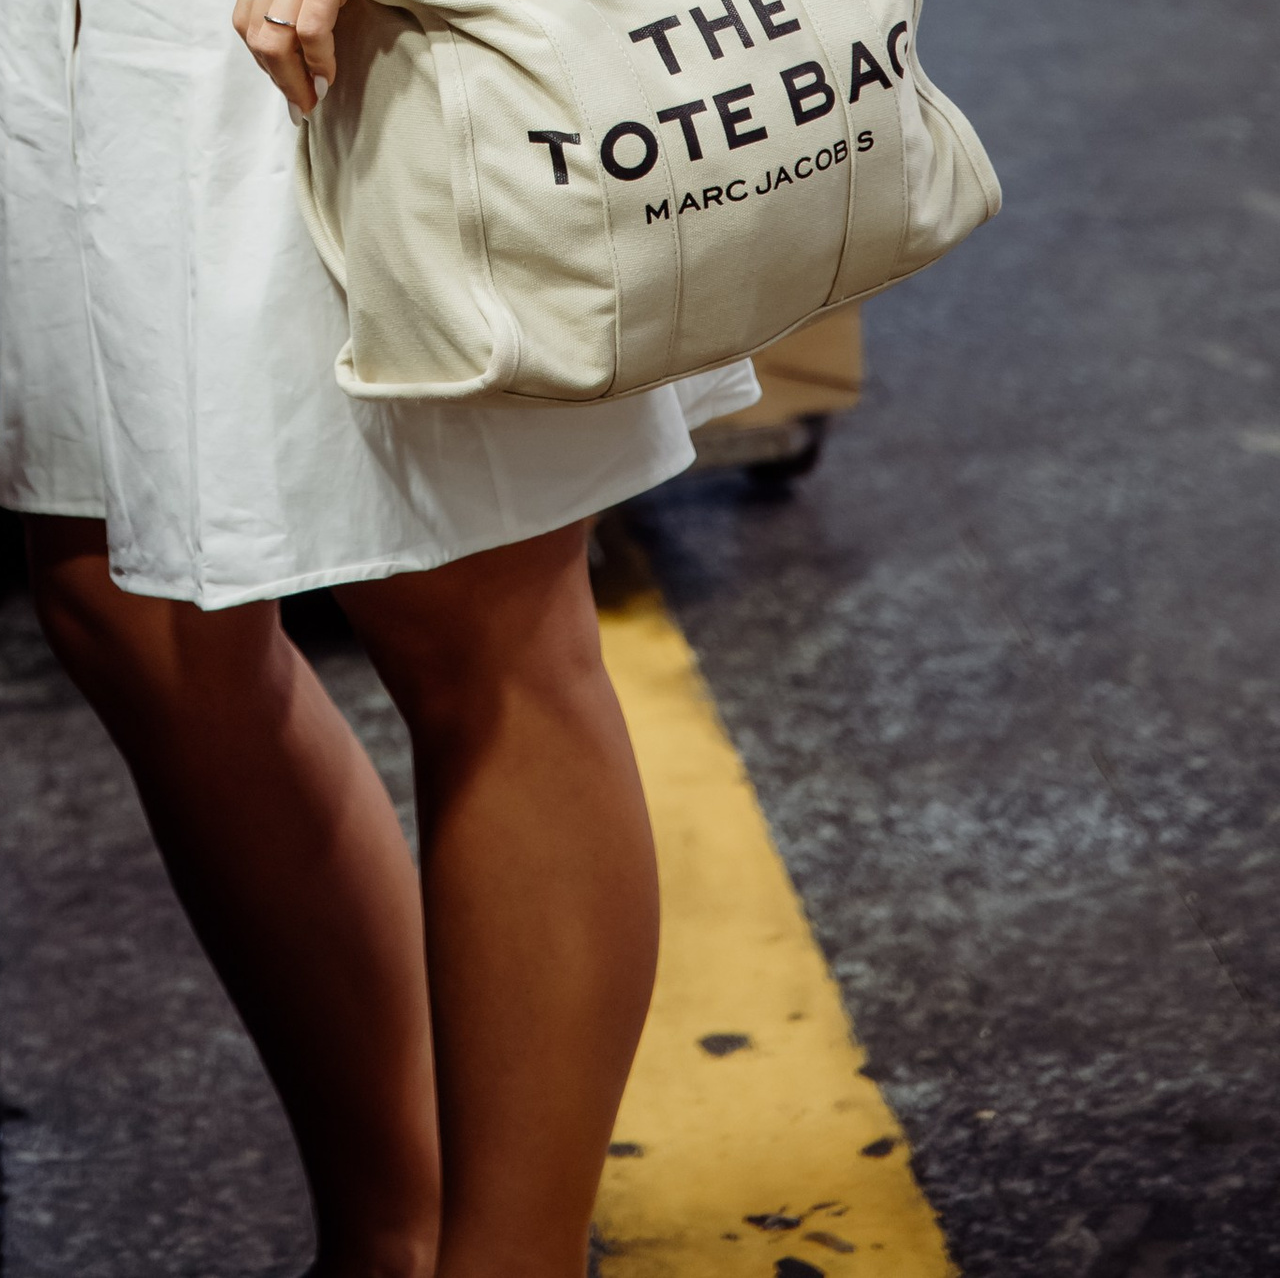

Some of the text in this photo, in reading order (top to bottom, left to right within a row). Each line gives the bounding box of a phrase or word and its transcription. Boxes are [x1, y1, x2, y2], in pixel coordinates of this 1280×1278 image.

[527, 83, 769, 185] TOTE
[644, 130, 875, 225] MARC JACOBS
